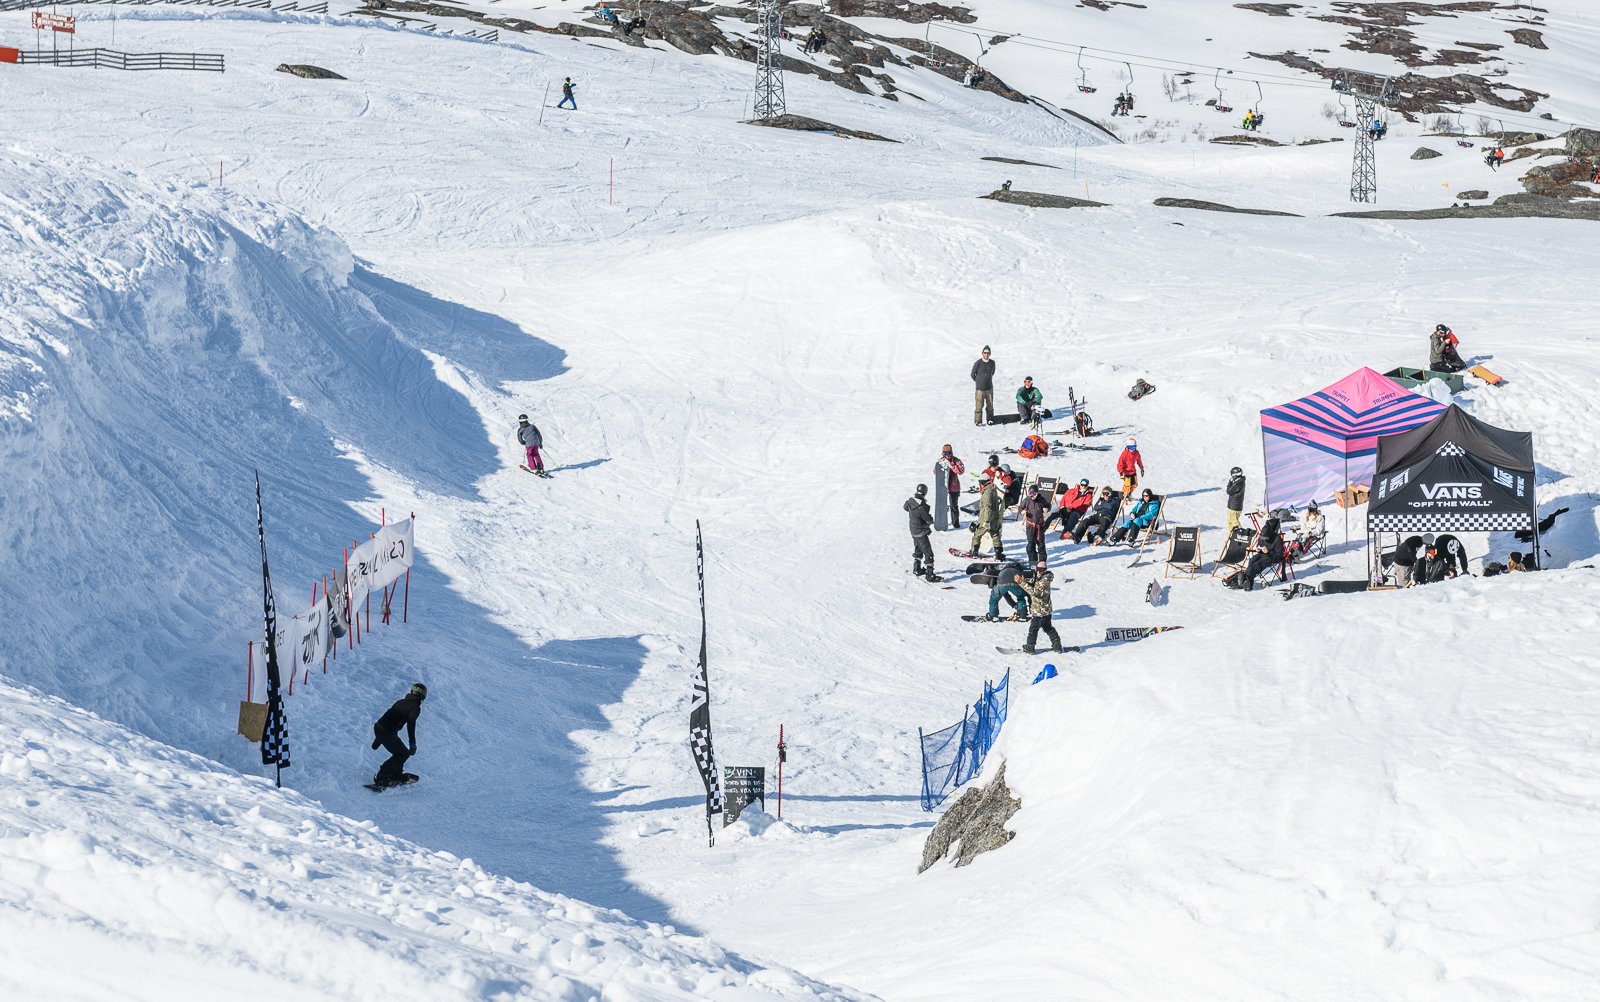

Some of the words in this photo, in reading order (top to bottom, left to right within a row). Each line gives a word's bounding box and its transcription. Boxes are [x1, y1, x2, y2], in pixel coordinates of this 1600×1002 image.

[1331, 389, 1350, 403] TRUMPET
[1372, 391, 1397, 405] TRUMPET
[1420, 482, 1482, 500] VANS
[1106, 630, 1120, 641] LIB
[1121, 628, 1142, 640] TECH
